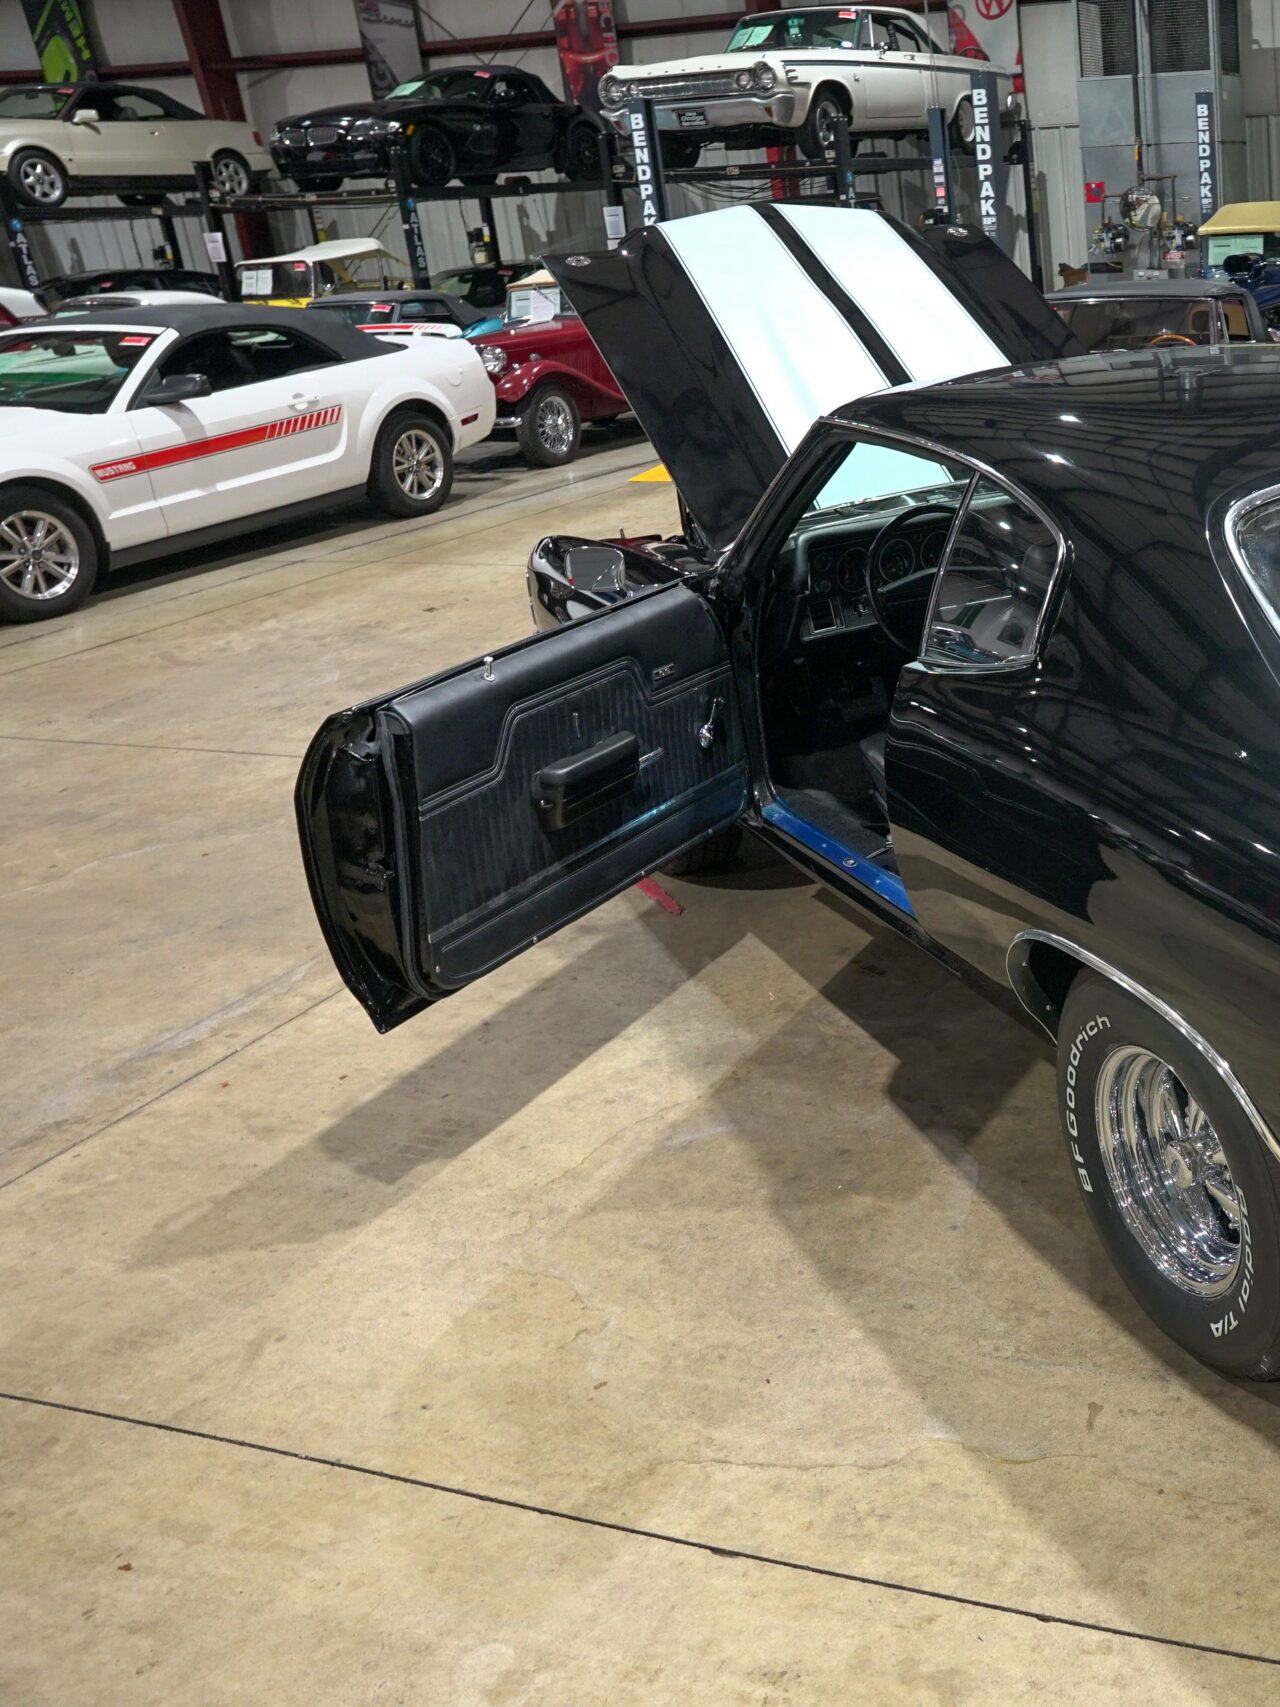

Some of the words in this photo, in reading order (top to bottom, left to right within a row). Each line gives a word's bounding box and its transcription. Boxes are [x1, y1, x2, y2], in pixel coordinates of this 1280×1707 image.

[630, 113, 657, 227] BENDPAK
[972, 88, 997, 216] BENDPAK
[1196, 104, 1213, 198] BENDPAK
[16, 232, 39, 286] ATLAS
[410, 211, 427, 268] ATLAS
[94, 461, 136, 477] MUSTANG
[1209, 1311, 1239, 1338] T/A
